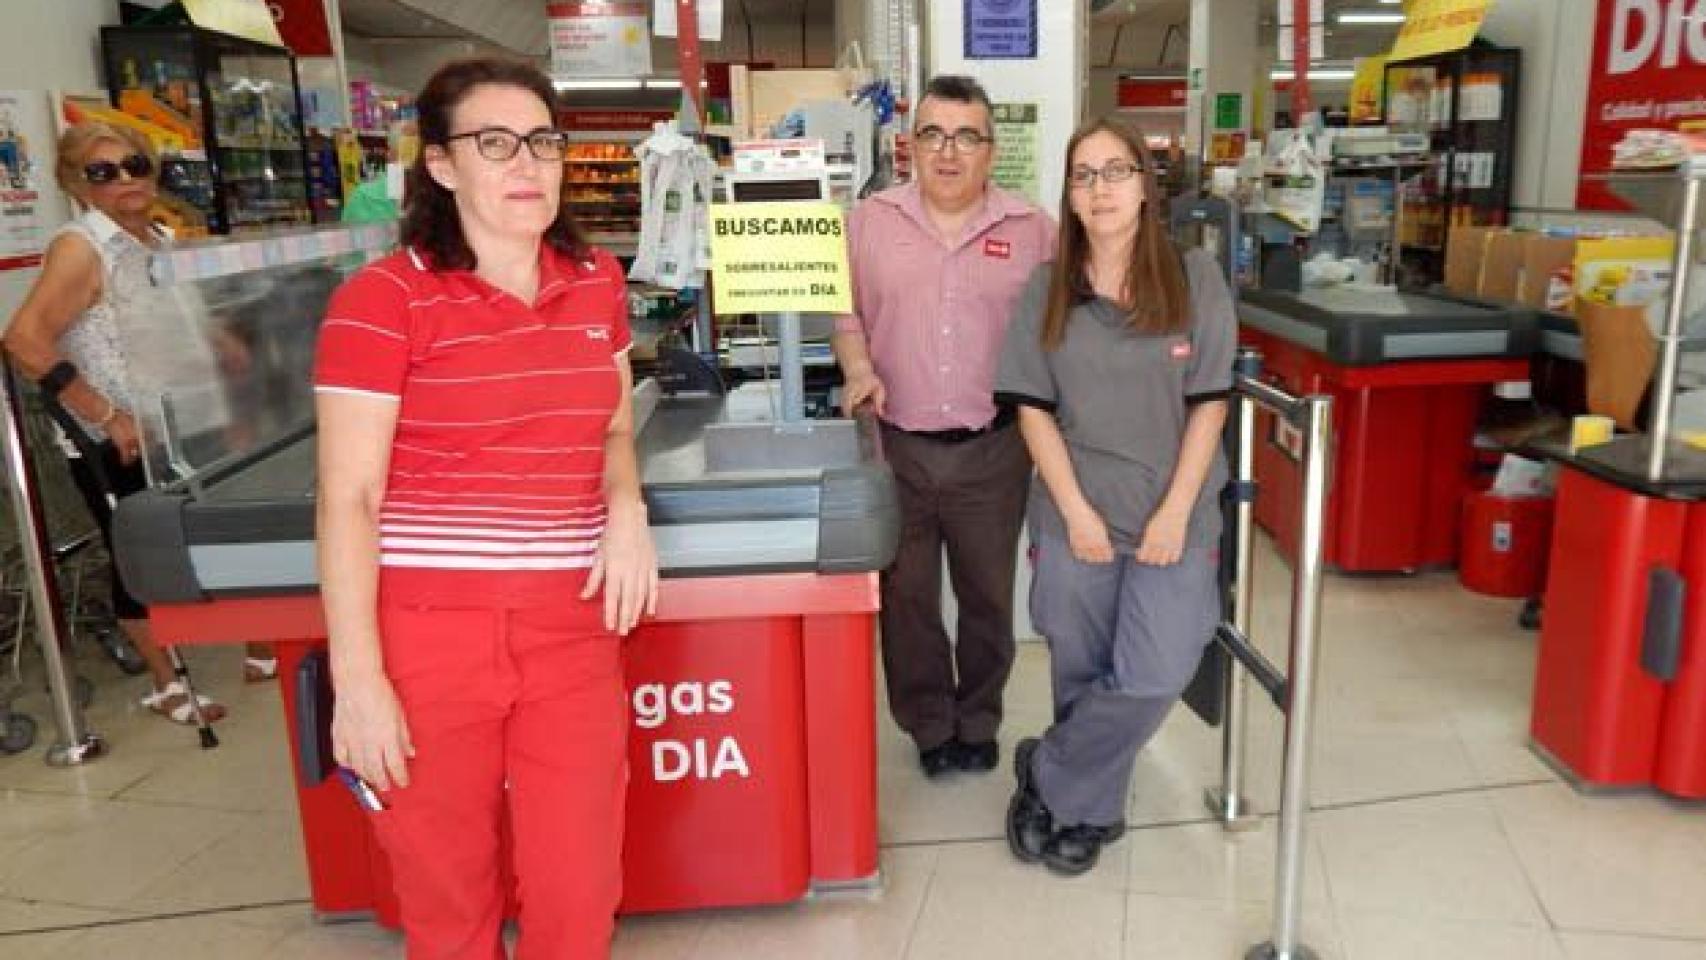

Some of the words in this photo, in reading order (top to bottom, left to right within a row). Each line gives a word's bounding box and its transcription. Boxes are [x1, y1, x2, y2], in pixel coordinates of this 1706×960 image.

[714, 217, 842, 237] BUSCAMOS
[625, 679, 735, 729] gas
[652, 736, 750, 782] DIA
